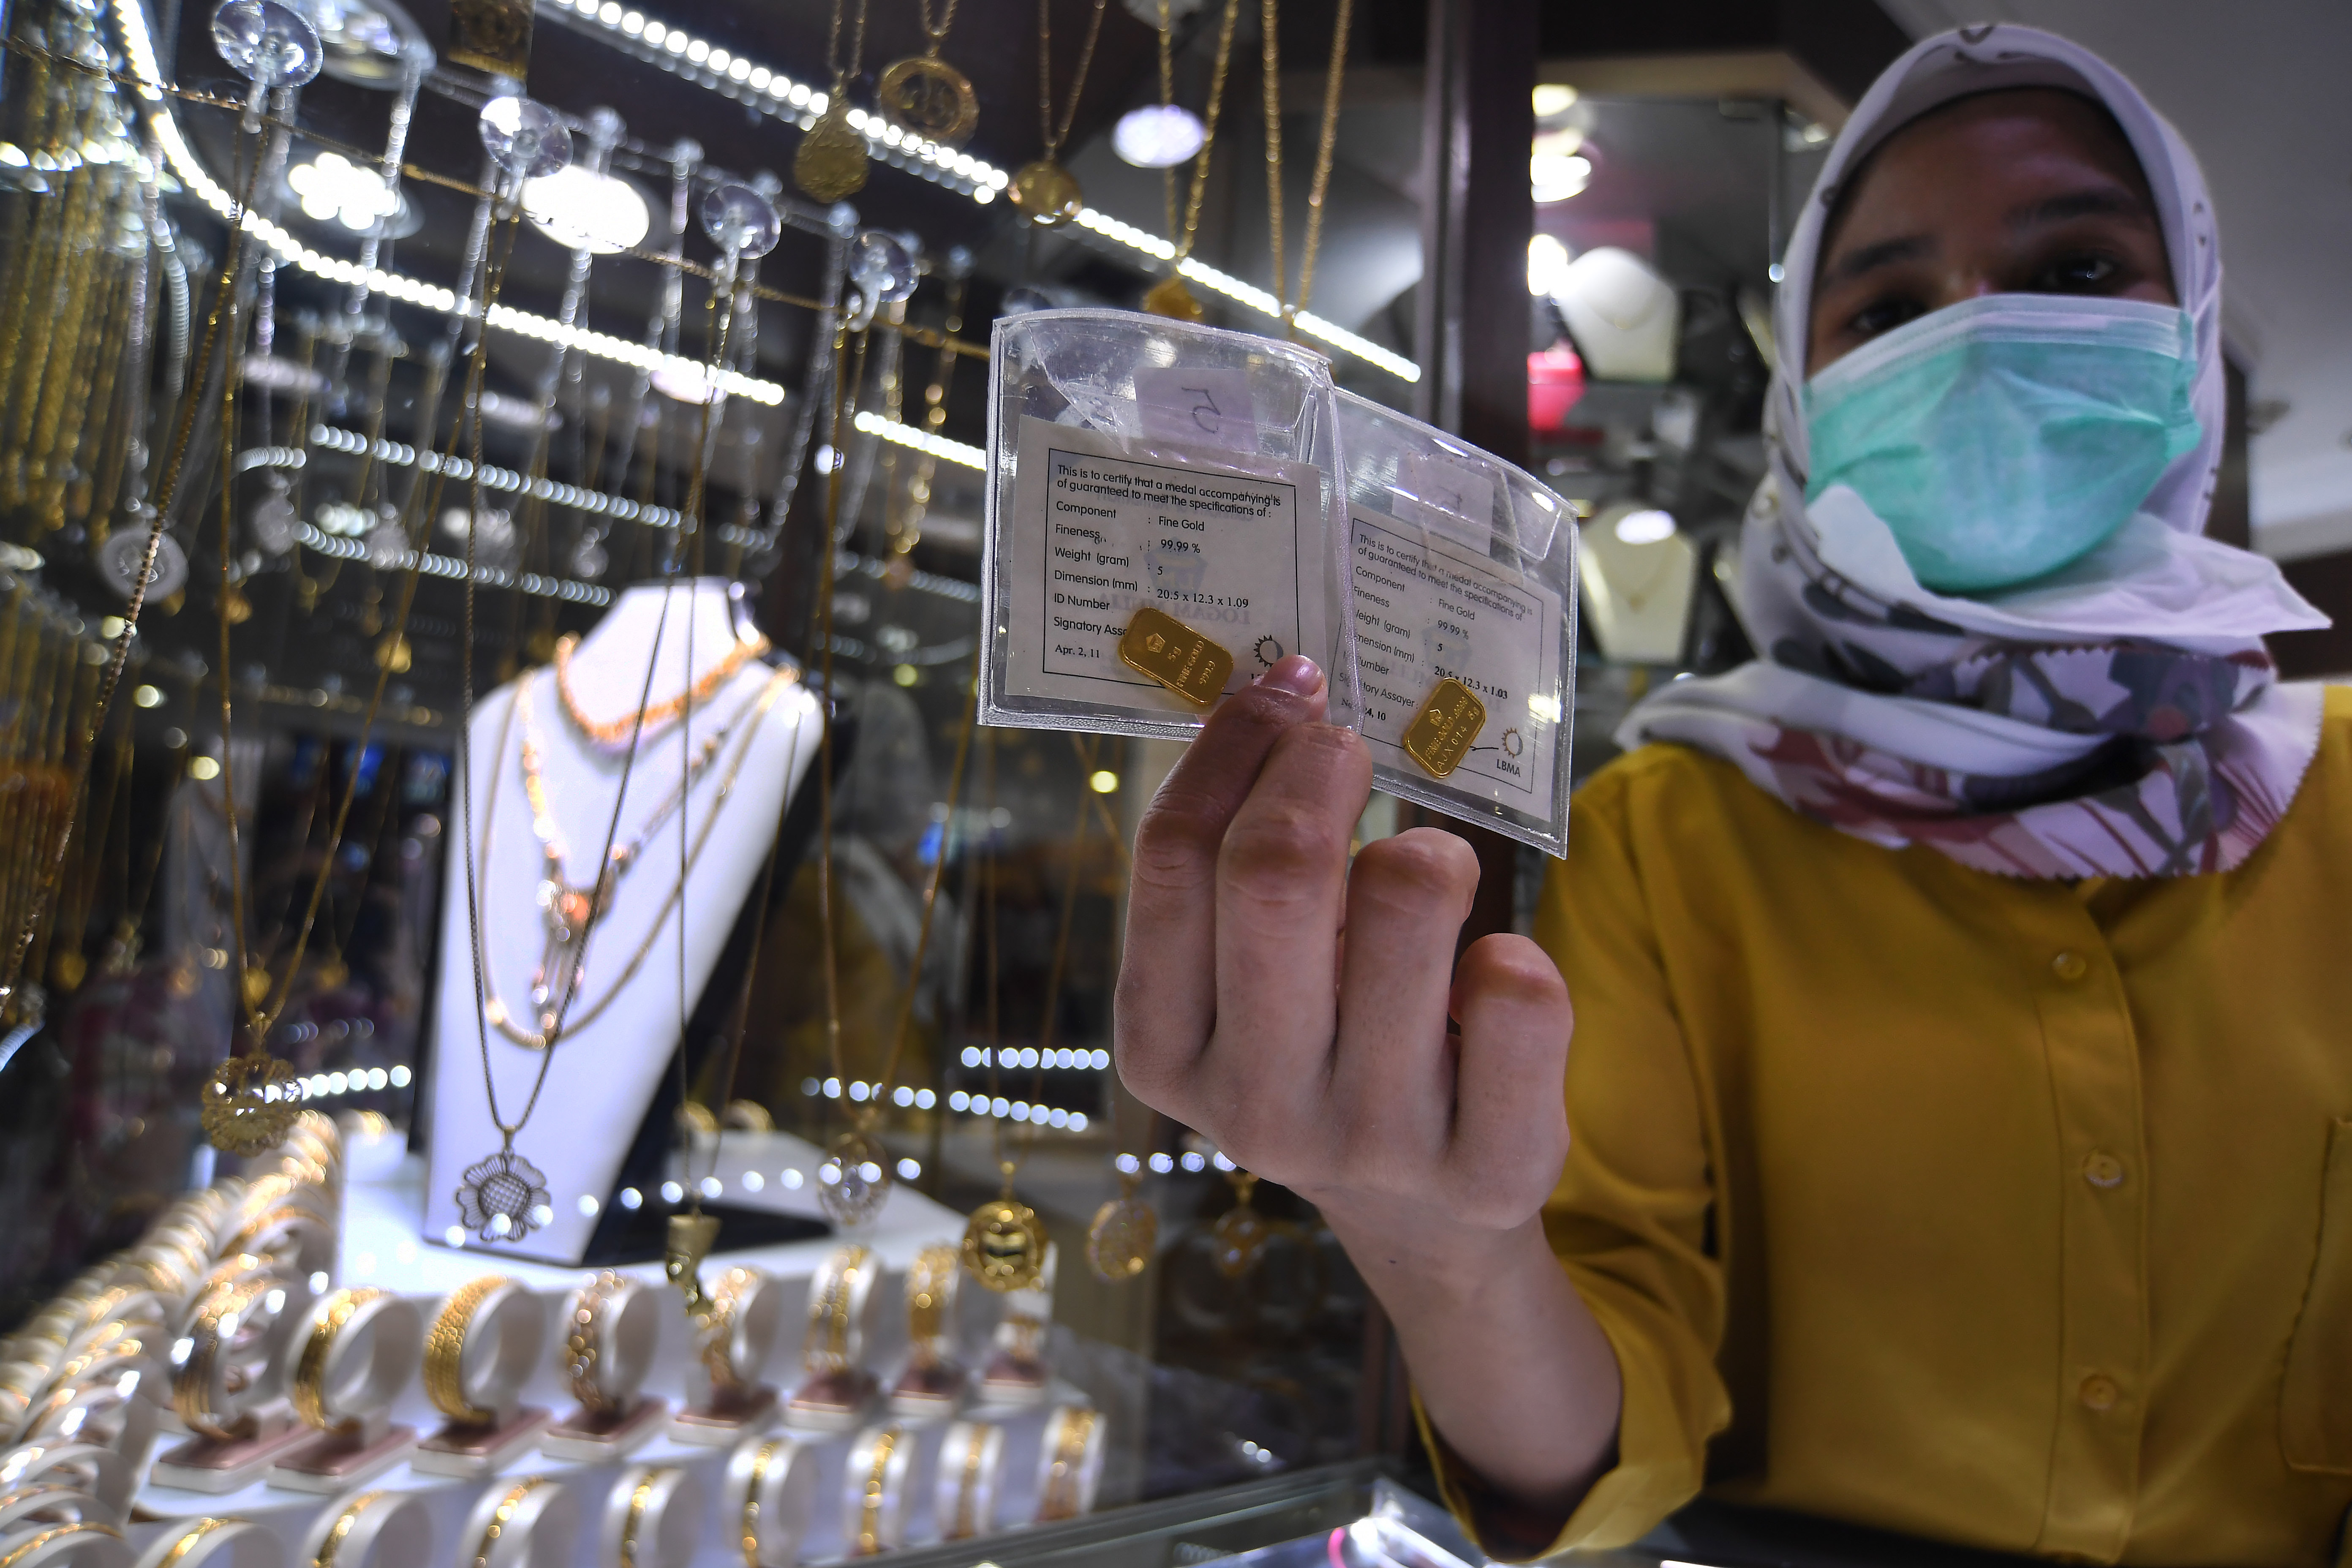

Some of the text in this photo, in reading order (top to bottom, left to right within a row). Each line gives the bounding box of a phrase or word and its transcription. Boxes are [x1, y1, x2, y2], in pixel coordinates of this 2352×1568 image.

[1057, 479, 1067, 488] of
[1069, 482, 1129, 498] guaranteed
[1132, 489, 1141, 499] to
[1143, 493, 1169, 504] meet
[1172, 495, 1187, 506] the
[1189, 498, 1254, 515] specifications
[1257, 507, 1266, 517] of
[1058, 464, 1281, 507] This is to certify that a medal accompanying is
[1056, 501, 1116, 519] Component
[1159, 516, 1179, 528] Fine
[1181, 519, 1205, 531] Gold
[1056, 523, 1100, 539] Fineness
[1161, 539, 1189, 552] 99.99
[1192, 543, 1200, 554] %
[1055, 546, 1091, 562] Weight
[1097, 553, 1129, 568] (gram)
[1157, 566, 1163, 575] 5
[1359, 534, 1376, 548] This
[1377, 541, 1385, 551] is
[1386, 545, 1394, 555] to
[1396, 550, 1421, 567] certify
[1473, 582, 1526, 613] accompanying
[1054, 569, 1109, 587] Dimension
[1112, 578, 1138, 592] (mm)
[1157, 588, 1179, 600] 20.5
[1193, 593, 1214, 605] 12.3
[1217, 597, 1224, 606] x
[1228, 597, 1249, 608] 1.09
[1356, 566, 1405, 592] Component
[1438, 598, 1455, 613] Fine
[1456, 606, 1475, 621] Gold
[1358, 547, 1523, 621] of guaranteed to meet the specifications of
[1054, 593, 1110, 610] ID Number
[1354, 586, 1390, 608] Fineness
[1462, 629, 1469, 640] %
[1054, 616, 1102, 635] Signatory
[1356, 609, 1380, 626] eight
[1384, 620, 1411, 640] (gram)
[1437, 643, 1443, 652] 5
[1055, 644, 1100, 659] Apr. 2, 11
[1359, 656, 1390, 675] umber
[1198, 660, 1216, 686] 999.9
[1394, 646, 1415, 664] (mm)
[1463, 676, 1481, 690] 12.3
[1483, 685, 1488, 693] x
[1491, 686, 1508, 700] 1.03
[1380, 688, 1415, 708] Assayer
[1496, 758, 1521, 777] LBMA
